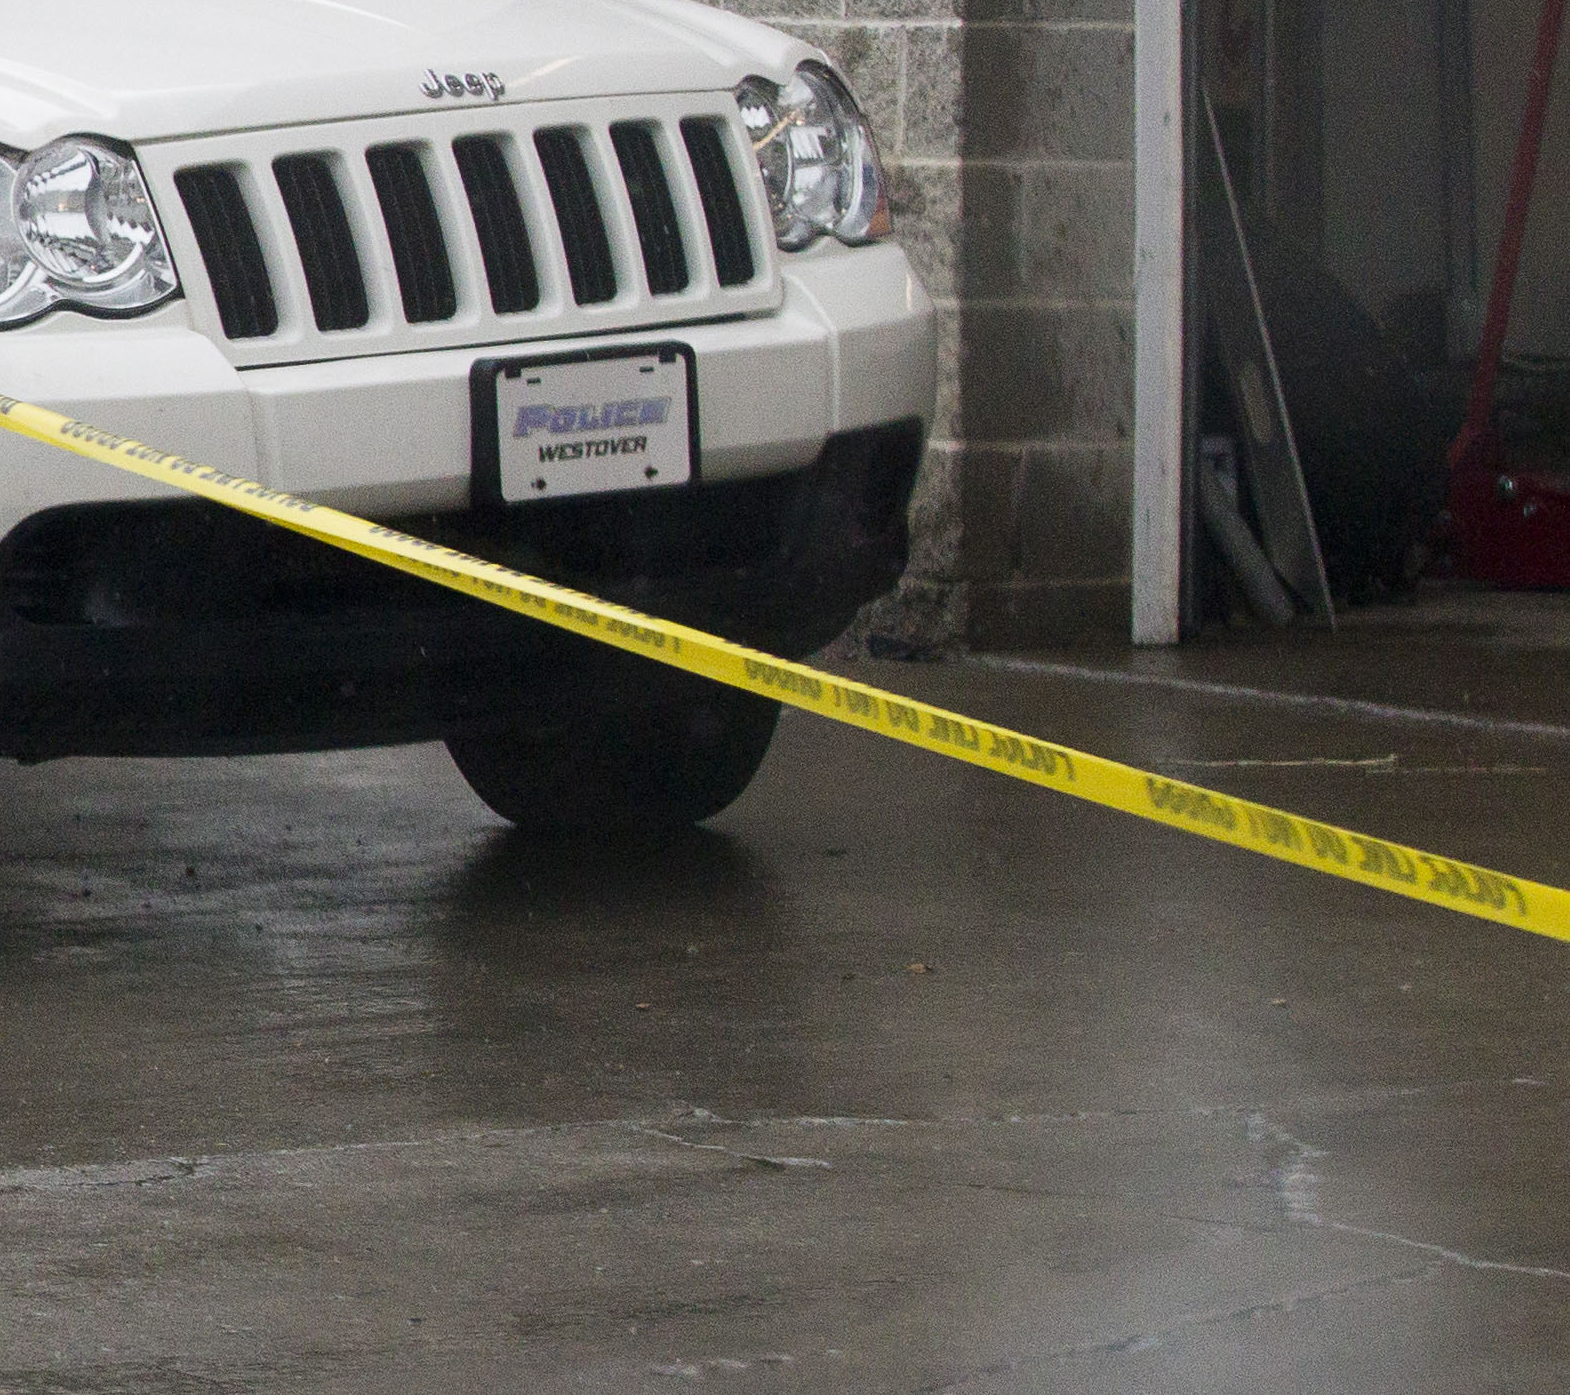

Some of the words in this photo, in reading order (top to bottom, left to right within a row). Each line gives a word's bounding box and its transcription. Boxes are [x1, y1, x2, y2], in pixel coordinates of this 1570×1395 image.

[420, 69, 505, 101] Jeep
[513, 396, 672, 438] POLICE
[539, 436, 647, 462] WESTOVER
